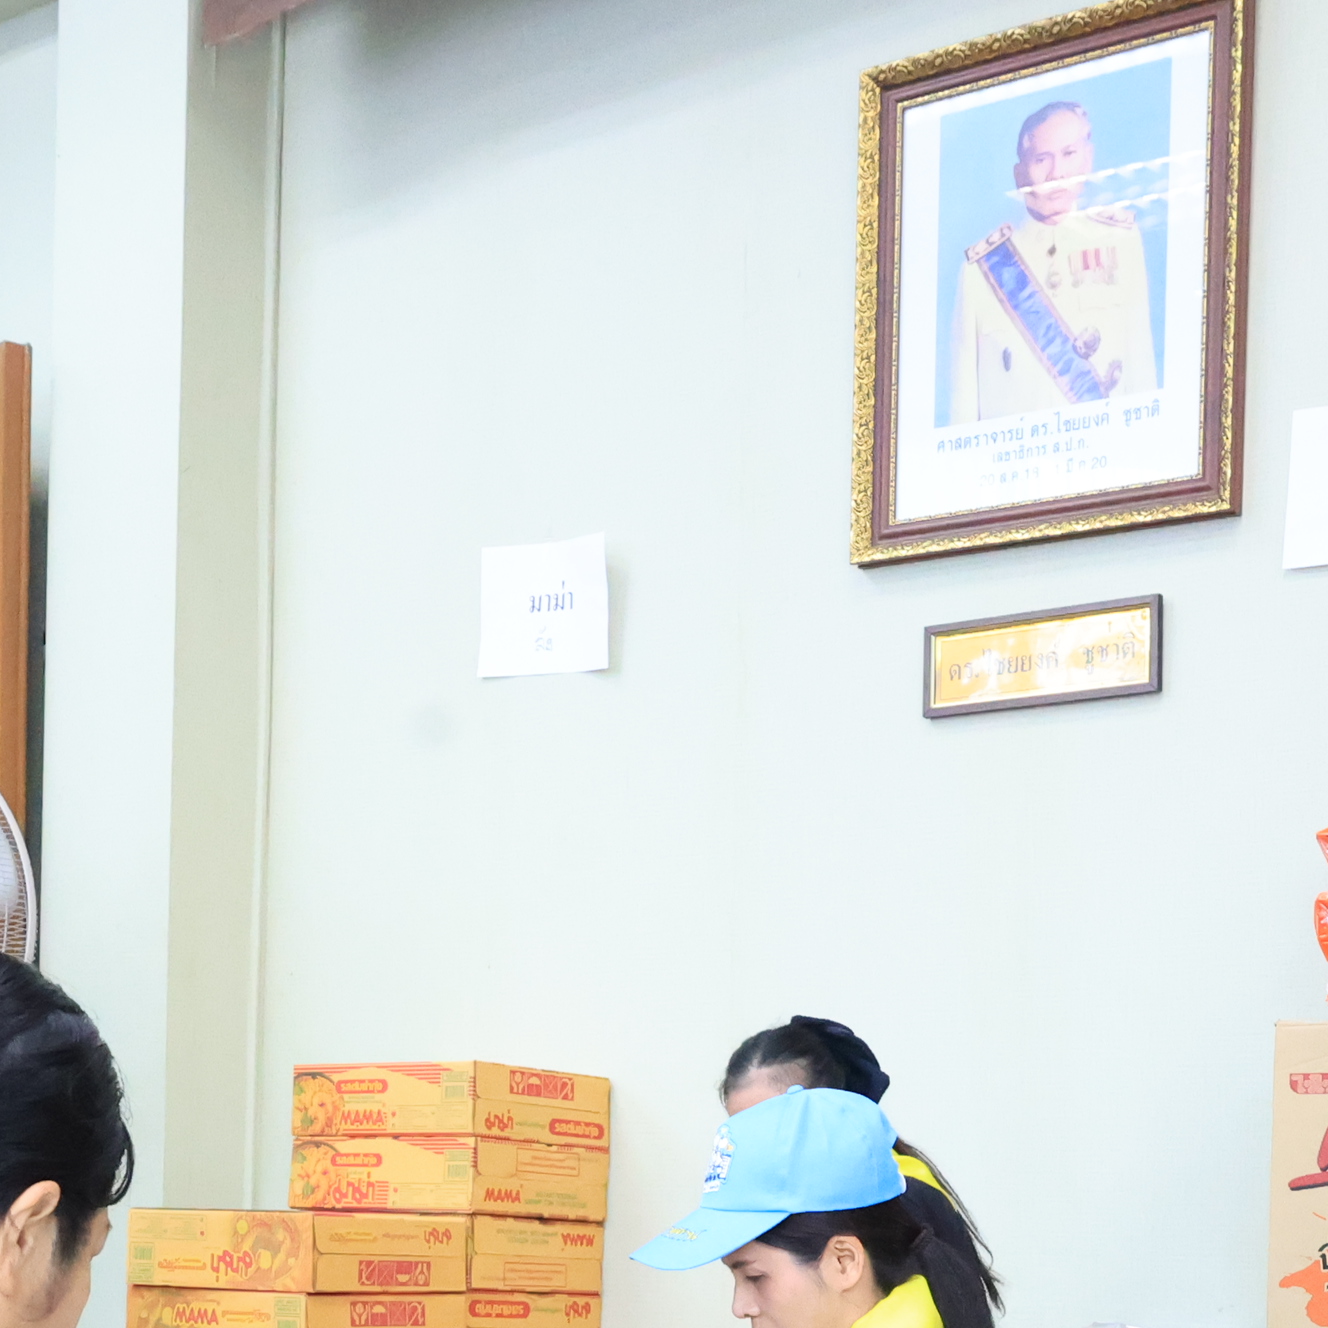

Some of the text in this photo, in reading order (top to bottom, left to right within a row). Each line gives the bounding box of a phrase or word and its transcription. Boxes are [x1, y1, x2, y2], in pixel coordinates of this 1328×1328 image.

[936, 416, 1025, 454] ศาสตราจารย์
[1122, 398, 1161, 428] ชูชาติ
[991, 444, 1048, 464] เลขาธิการ
[528, 579, 574, 613] มาม่า
[1082, 631, 1136, 675] ชูชาติ
[339, 1108, 385, 1127] MAMA
[484, 1187, 522, 1204] MAMA
[173, 1303, 220, 1326] MAMA
